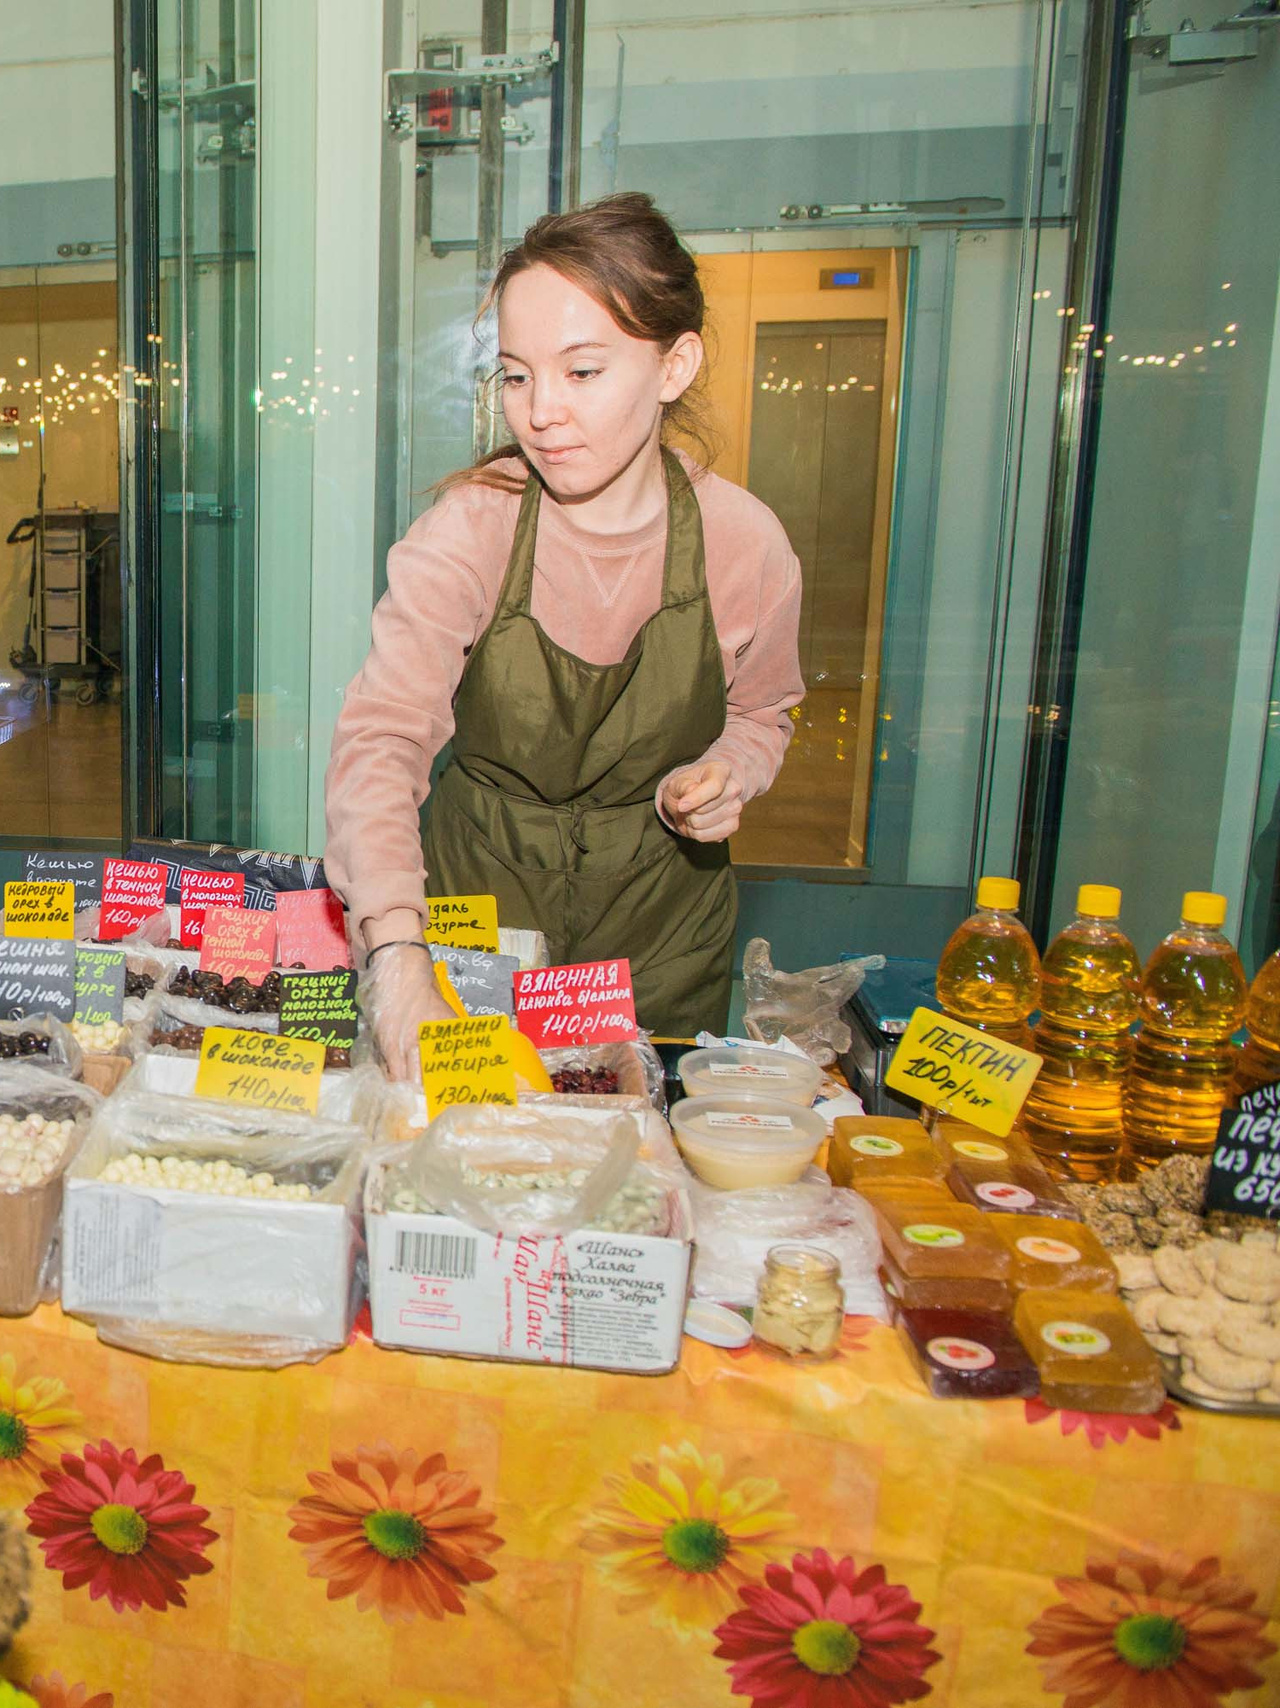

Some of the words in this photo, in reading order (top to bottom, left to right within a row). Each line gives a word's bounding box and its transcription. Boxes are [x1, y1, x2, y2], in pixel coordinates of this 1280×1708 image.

[104, 892, 166, 910] шоколаде
[6, 908, 70, 923] шоколаде
[518, 963, 619, 994] ВЯЛЕННАЯ
[280, 1008, 358, 1021] шоколаде
[207, 1043, 221, 1060] в
[221, 1048, 316, 1075] шоколаде
[423, 1054, 509, 1075] имбиря
[918, 1025, 1027, 1082] ПЕКТИН
[1213, 1145, 1249, 1173] из
